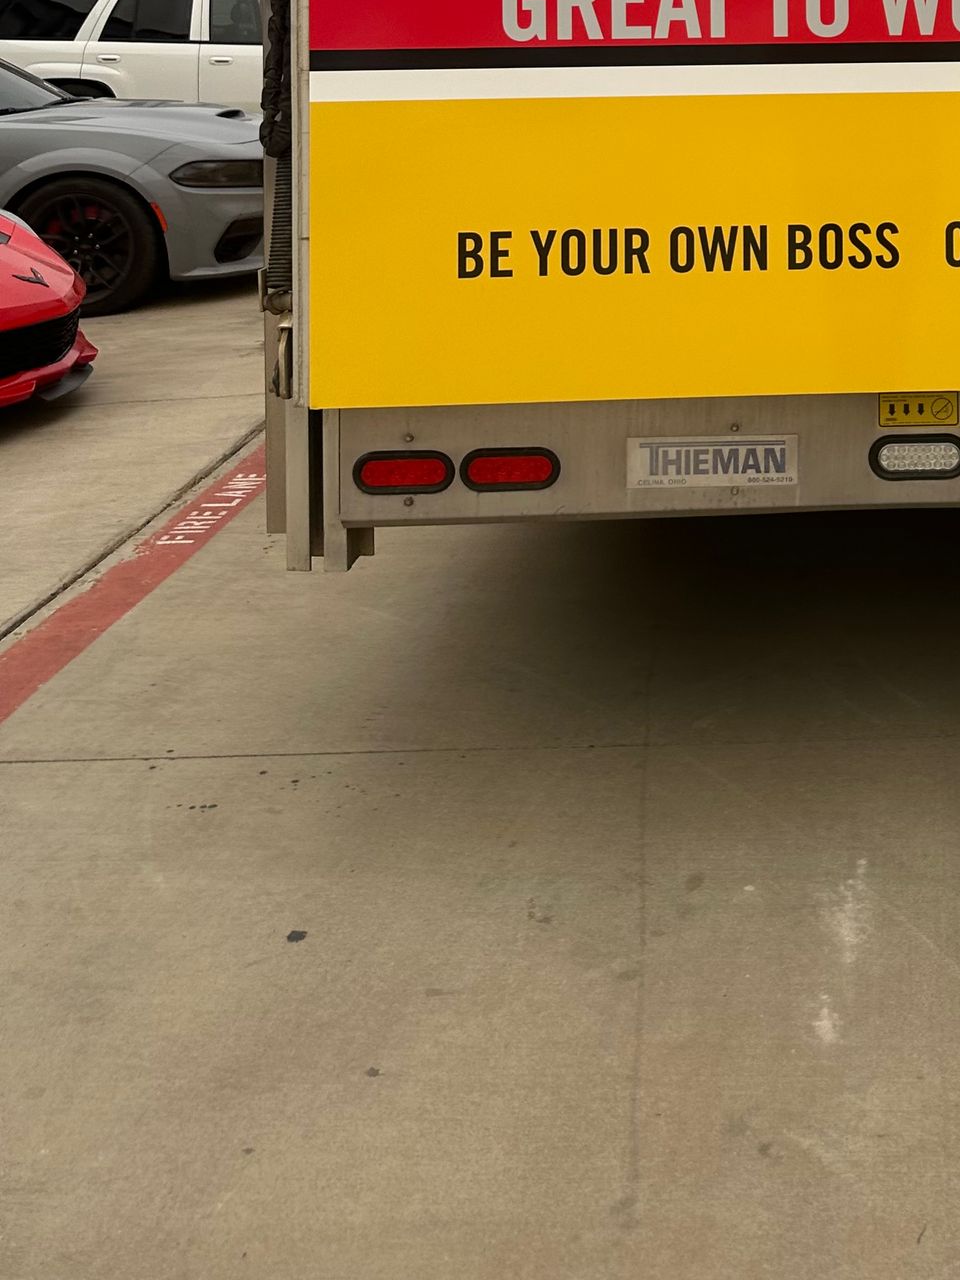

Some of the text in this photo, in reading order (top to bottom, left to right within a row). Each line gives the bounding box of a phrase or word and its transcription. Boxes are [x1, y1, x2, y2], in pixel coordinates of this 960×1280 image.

[457, 230, 513, 279] BE
[530, 228, 651, 276] YOUR
[669, 225, 768, 273] OWN
[787, 222, 900, 270] BOSS
[639, 440, 786, 476] THIEMAN
[155, 473, 267, 545] FIRE LANE
